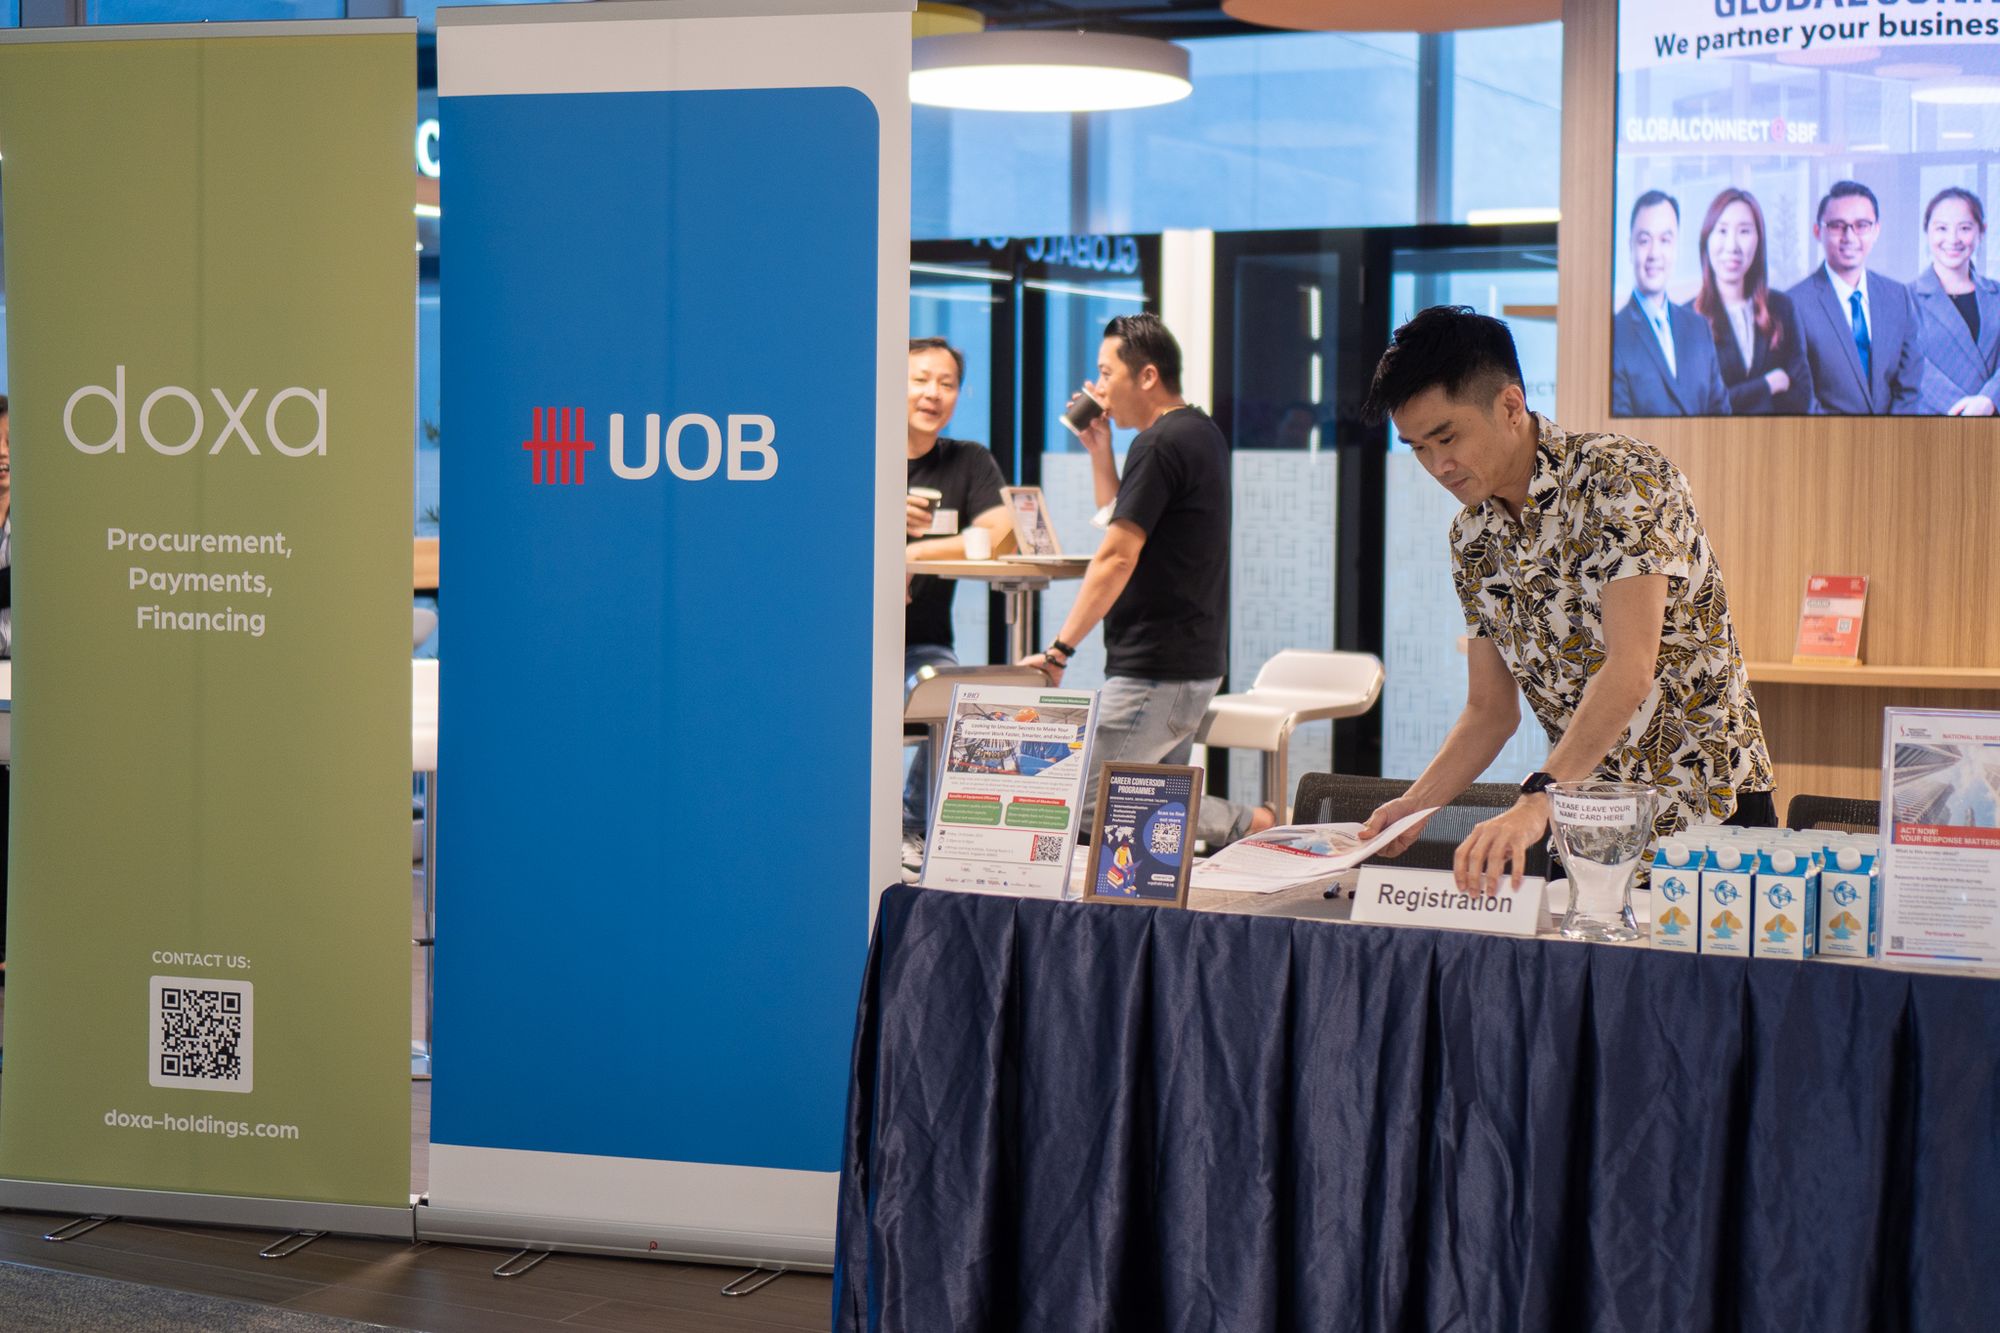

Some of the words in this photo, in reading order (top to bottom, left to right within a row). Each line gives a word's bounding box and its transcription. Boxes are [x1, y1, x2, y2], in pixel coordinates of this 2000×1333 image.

[1654, 33, 1688, 57] We
[1697, 24, 1792, 59] partner
[1801, 20, 1869, 49] your
[63, 365, 328, 457] doxa
[609, 412, 779, 482] UOB
[107, 527, 293, 559] Procurement,
[129, 567, 273, 598] Payments,
[136, 606, 266, 637] Financing
[964, 729, 991, 737] Equipment
[1110, 776, 1132, 785] CAREER
[1131, 778, 1166, 787] CONVERSION
[1117, 785, 1156, 795] PROGRAMMES
[1555, 800, 1580, 811] PLEASE
[1581, 804, 1606, 812] LEAVE
[1559, 811, 1577, 820] NAME
[1579, 813, 1602, 821] CARD
[1901, 834, 1922, 842] YOUR
[1922, 835, 1964, 844] RESPONSE
[1917, 827, 1939, 835] NOW!
[1377, 883, 1513, 914] Registration
[152, 950, 223, 968] CONTACT
[226, 953, 252, 970] US:
[104, 1109, 300, 1140] doxa-holdings.com
